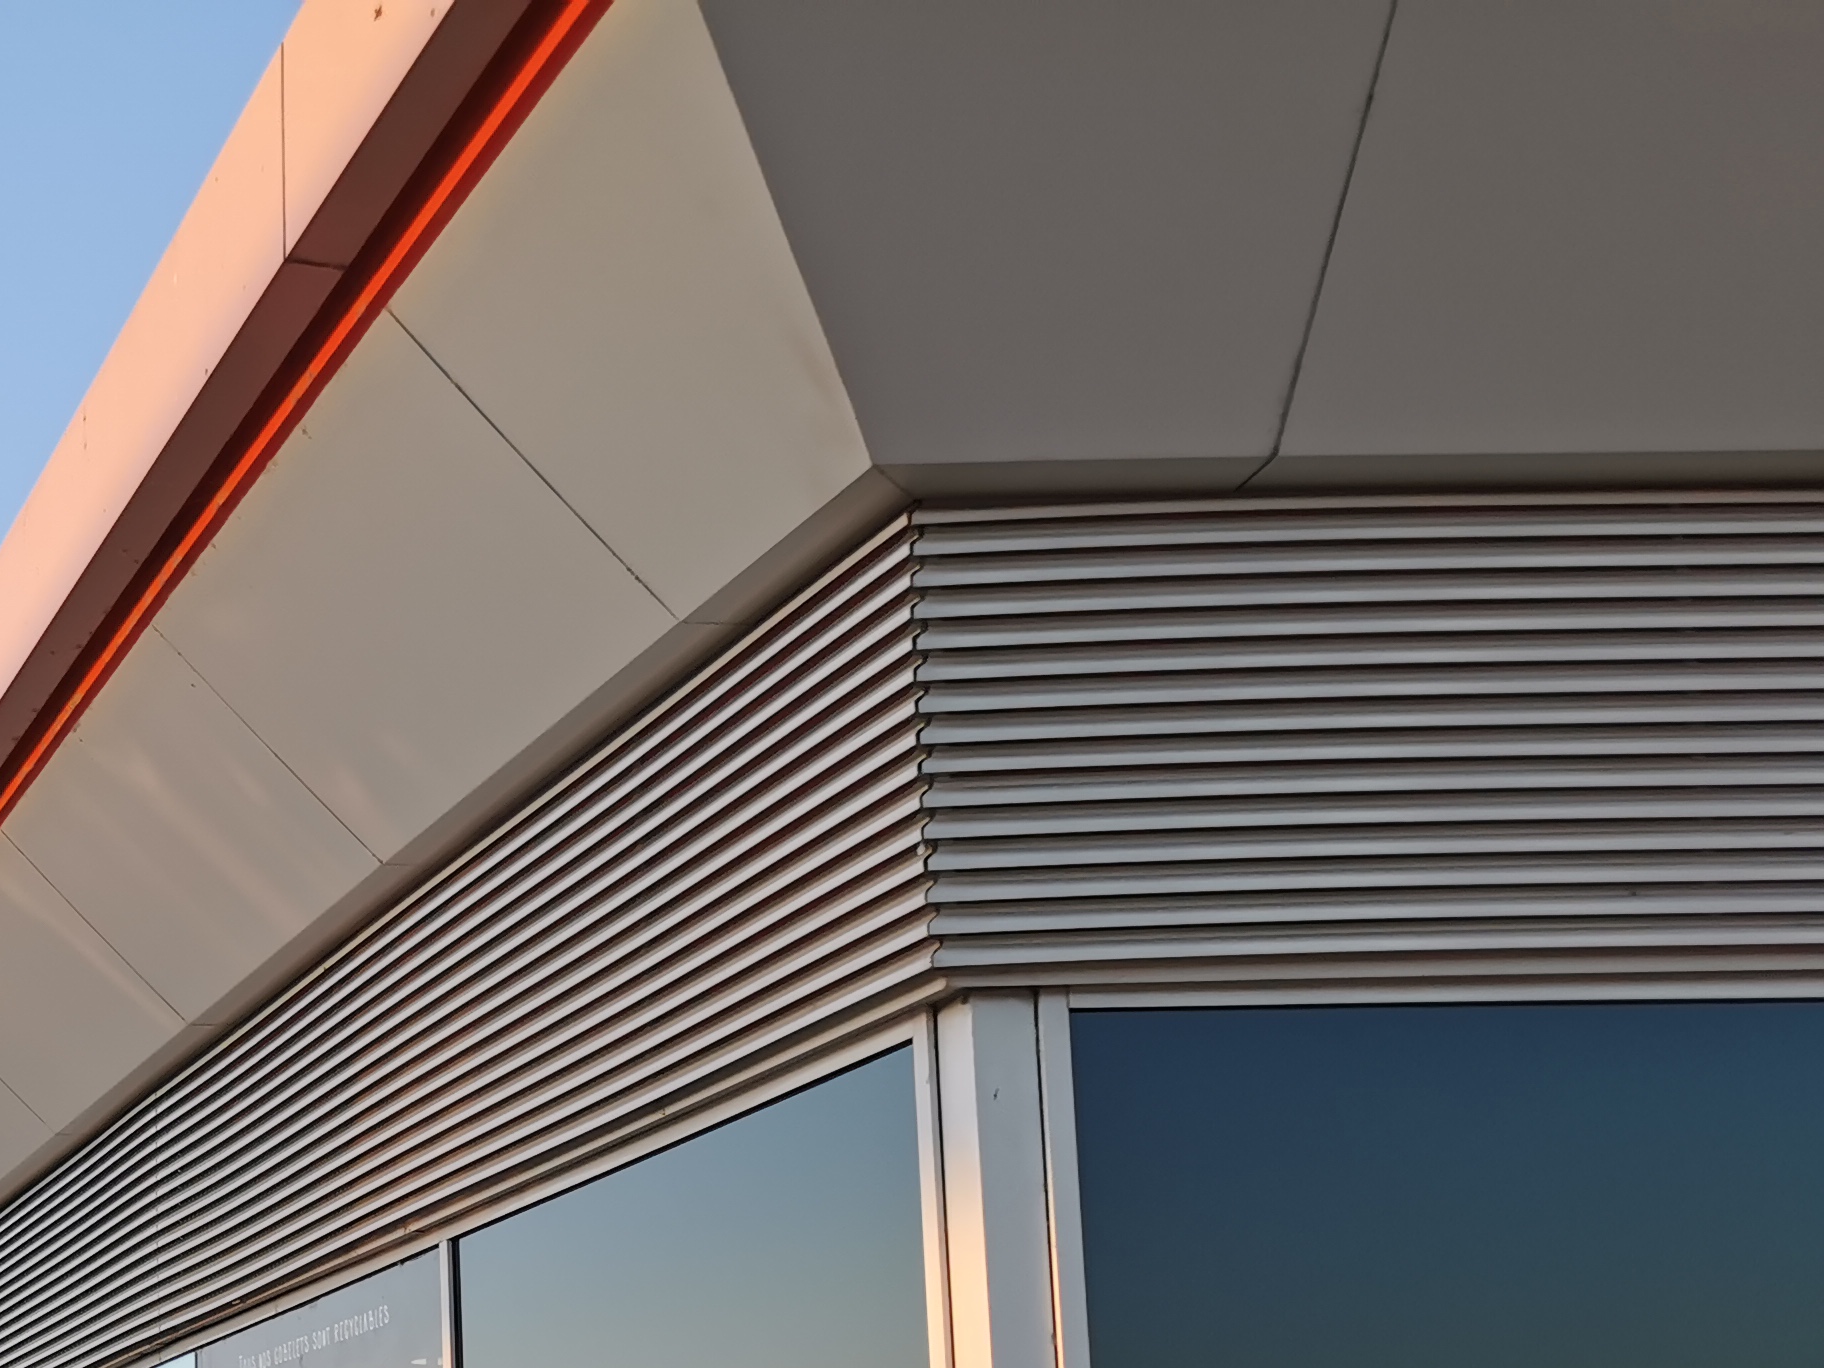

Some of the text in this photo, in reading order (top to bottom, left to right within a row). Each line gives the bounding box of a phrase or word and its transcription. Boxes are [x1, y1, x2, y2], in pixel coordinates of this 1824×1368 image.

[273, 1335, 309, 1366] GOBELETS
[312, 1326, 331, 1350] SONT
[334, 1304, 390, 1344] RECYCLABLES
